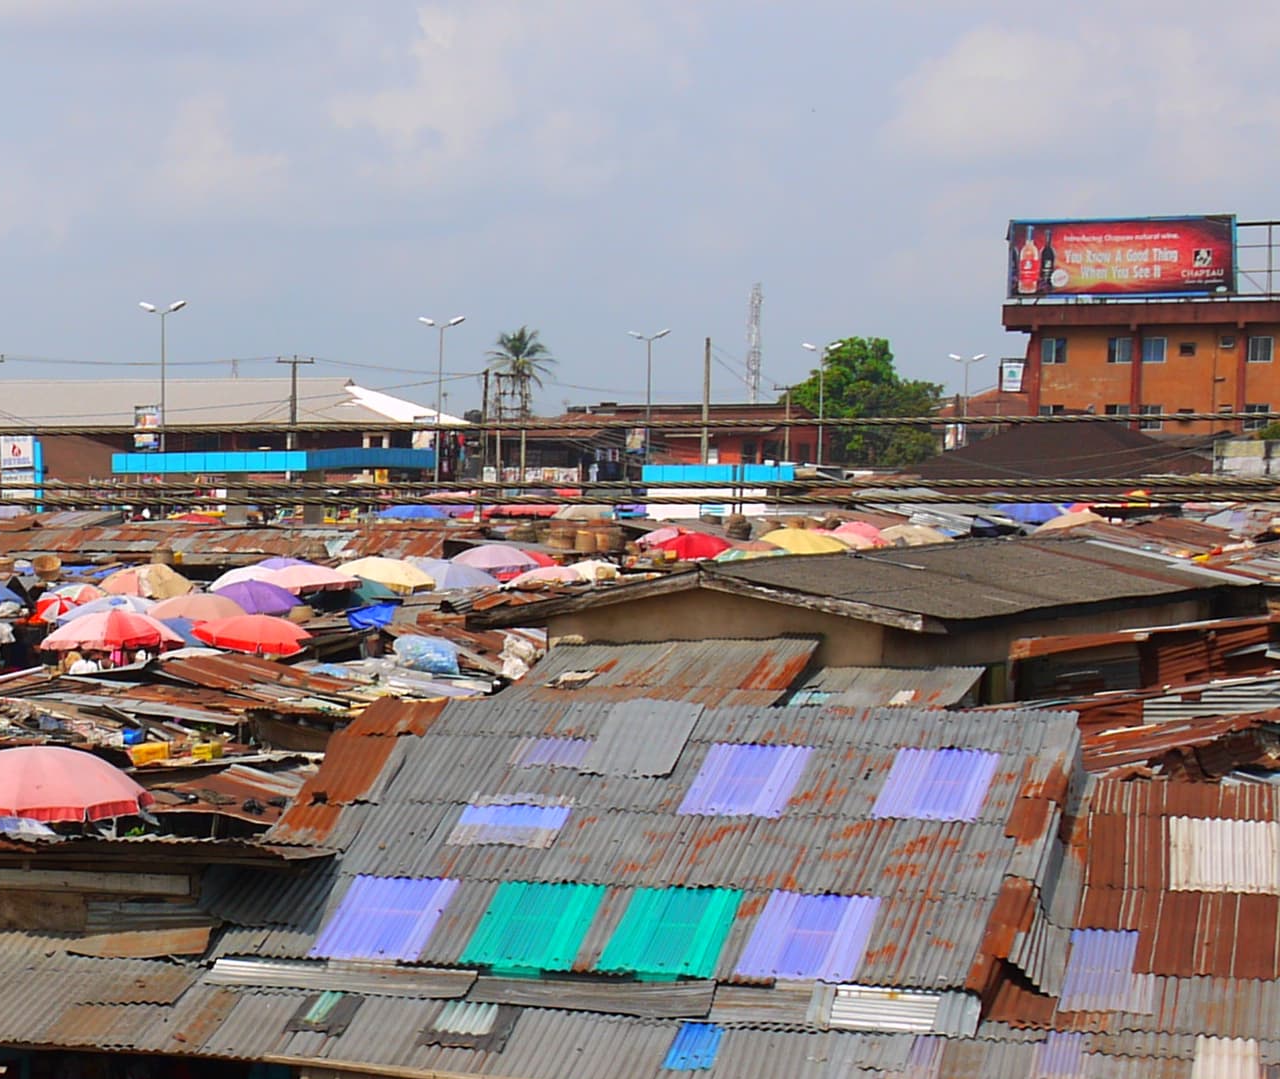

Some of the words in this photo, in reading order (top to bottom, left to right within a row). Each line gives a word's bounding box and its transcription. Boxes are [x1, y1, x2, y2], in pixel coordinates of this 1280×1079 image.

[1065, 250, 1082, 264] You
[1086, 249, 1112, 264] Know
[1115, 249, 1123, 263] A
[1126, 249, 1150, 263] Good
[1153, 248, 1179, 264] Thing
[1081, 264, 1108, 280] When
[1112, 265, 1130, 279] You
[1134, 264, 1152, 278] See
[1181, 268, 1224, 278] CHAPEAU
